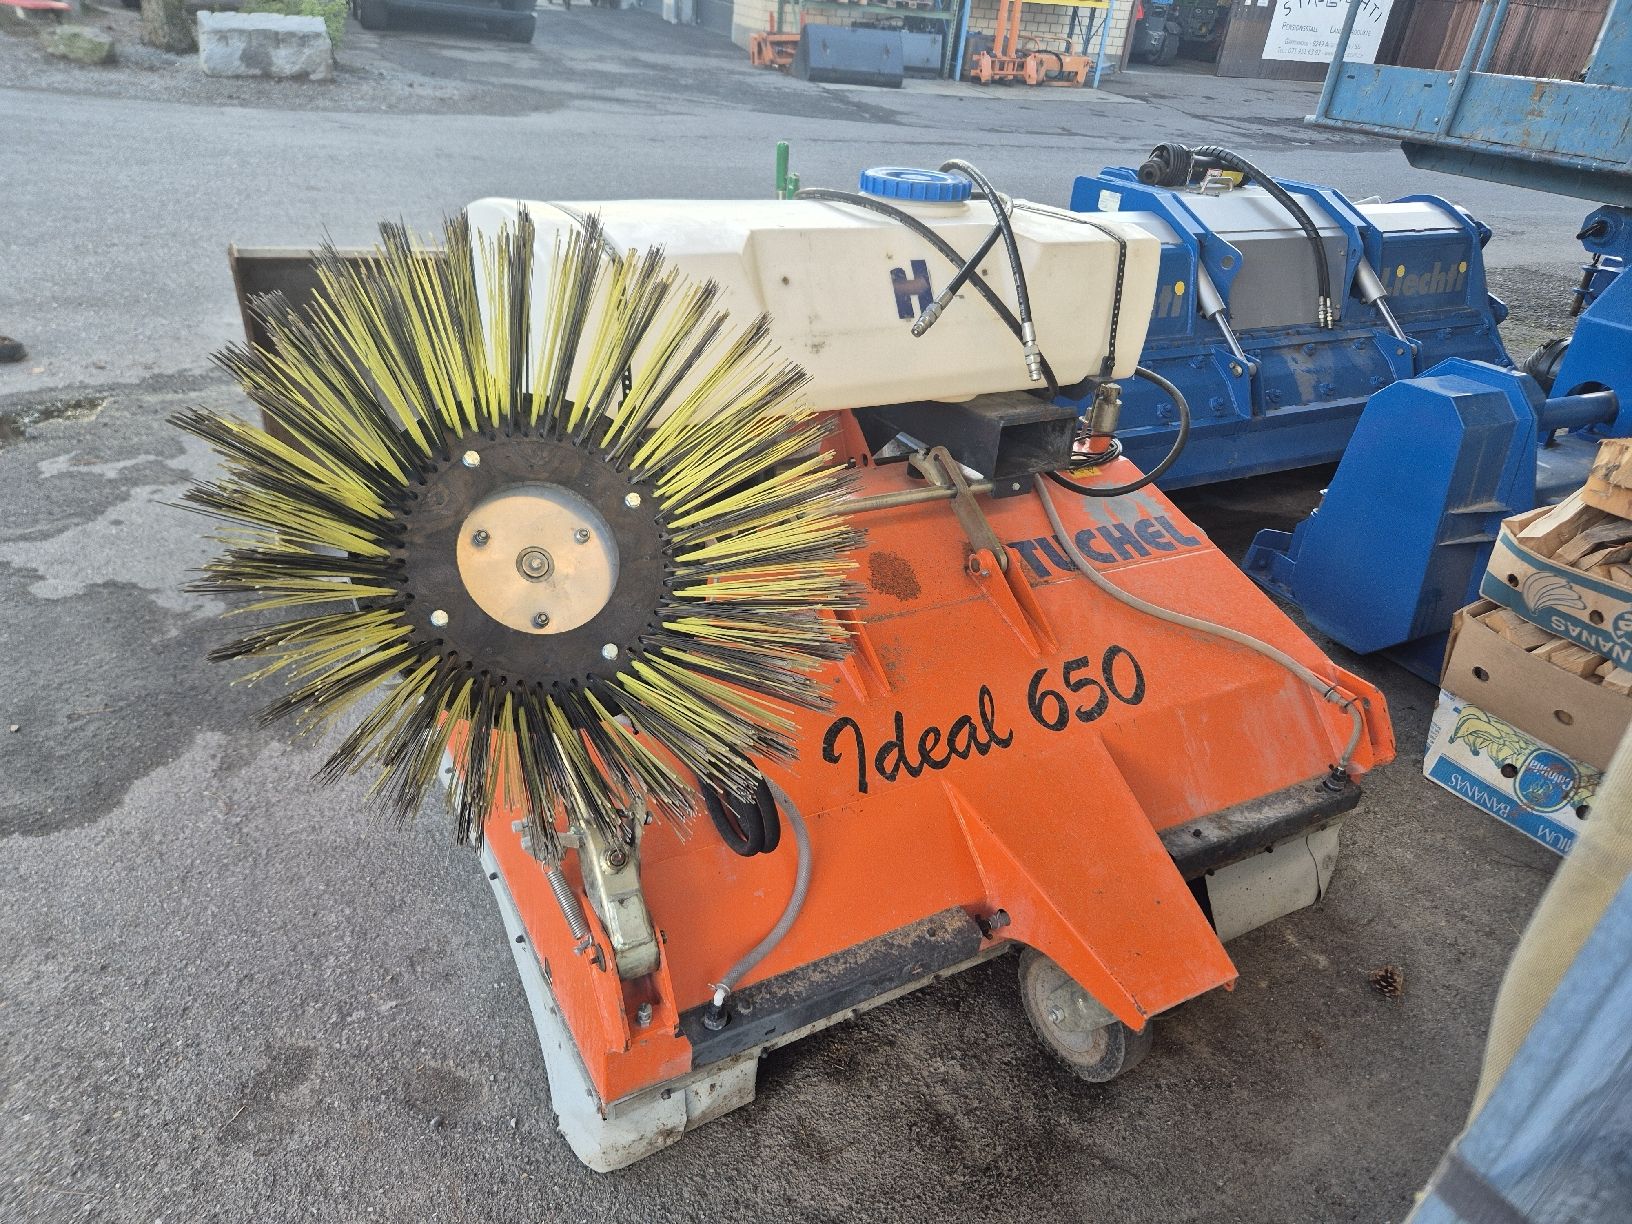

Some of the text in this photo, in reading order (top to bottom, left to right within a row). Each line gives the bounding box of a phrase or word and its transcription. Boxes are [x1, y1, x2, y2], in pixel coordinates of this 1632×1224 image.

[1381, 261, 1467, 297] Liechti
[1007, 515, 1201, 578] TUCHEL
[821, 644, 1146, 794] Ideal 650
[1447, 772, 1511, 818] BANANAS
